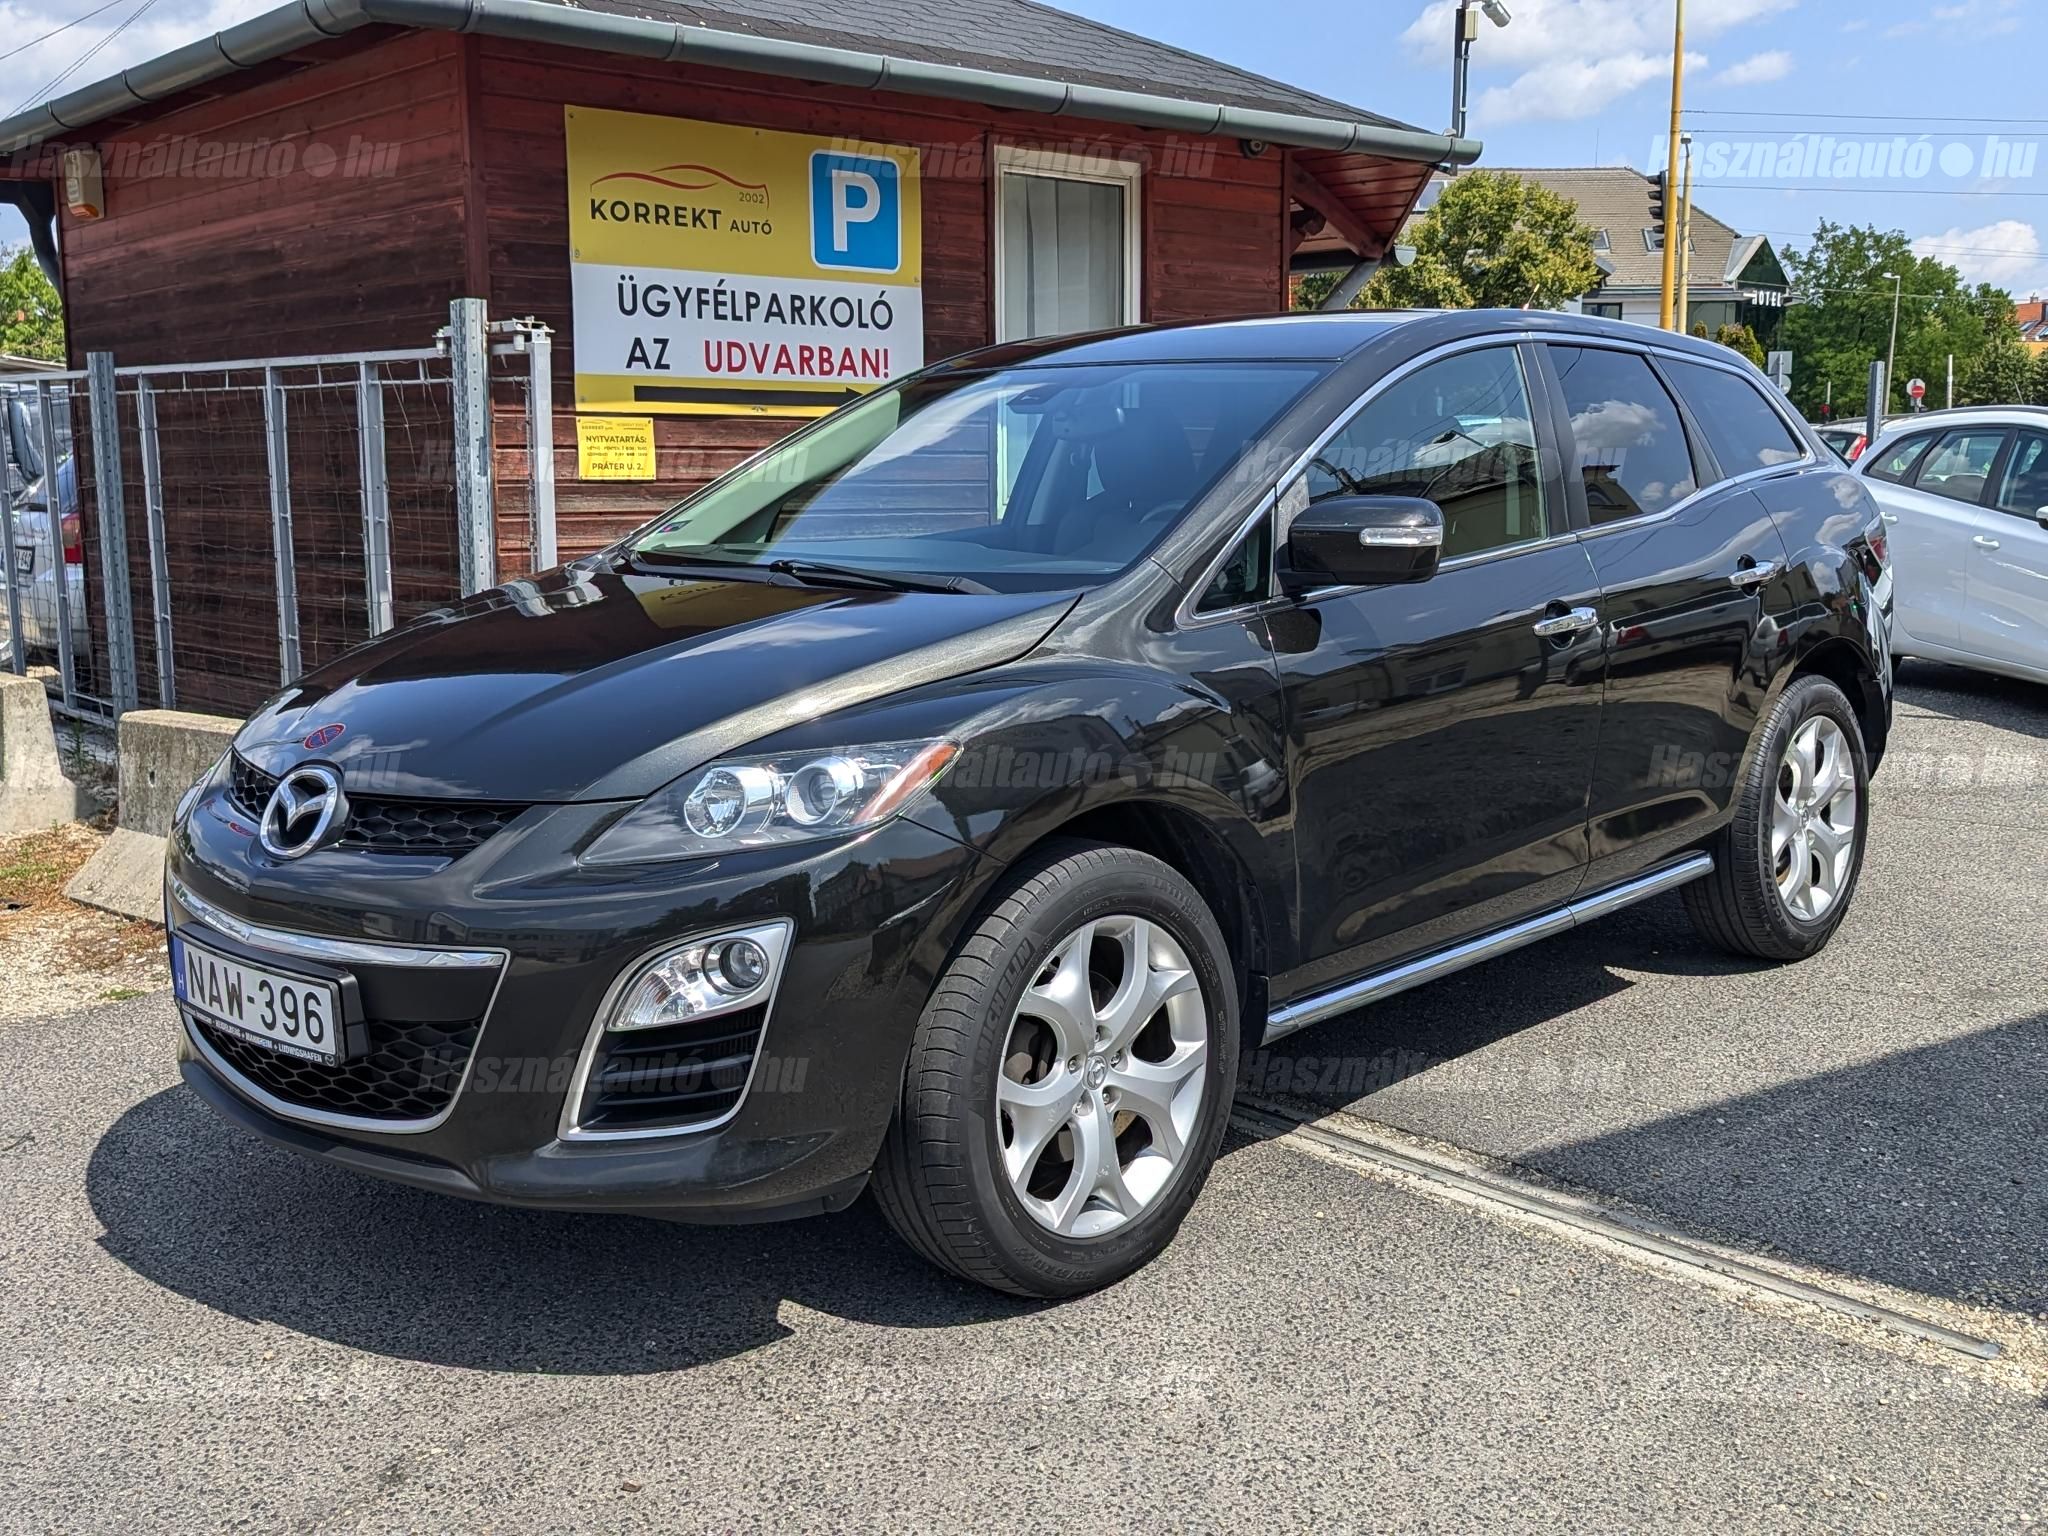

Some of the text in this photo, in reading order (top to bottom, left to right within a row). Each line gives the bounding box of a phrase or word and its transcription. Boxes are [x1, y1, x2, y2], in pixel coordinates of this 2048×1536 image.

[589, 199, 773, 236] KORREKT AUTÓ
[739, 192, 765, 205] 2002
[831, 169, 881, 252] P
[616, 274, 894, 331] ÜGYFÉLPARKOLÓ
[625, 337, 890, 379] AZ UDVARBAN!
[586, 434, 647, 444] NYITVATARTÁS:
[592, 461, 625, 471] PRÁTER
[187, 950, 325, 1044] NAW-396
[974, 936, 1037, 1067] MICHELIN
